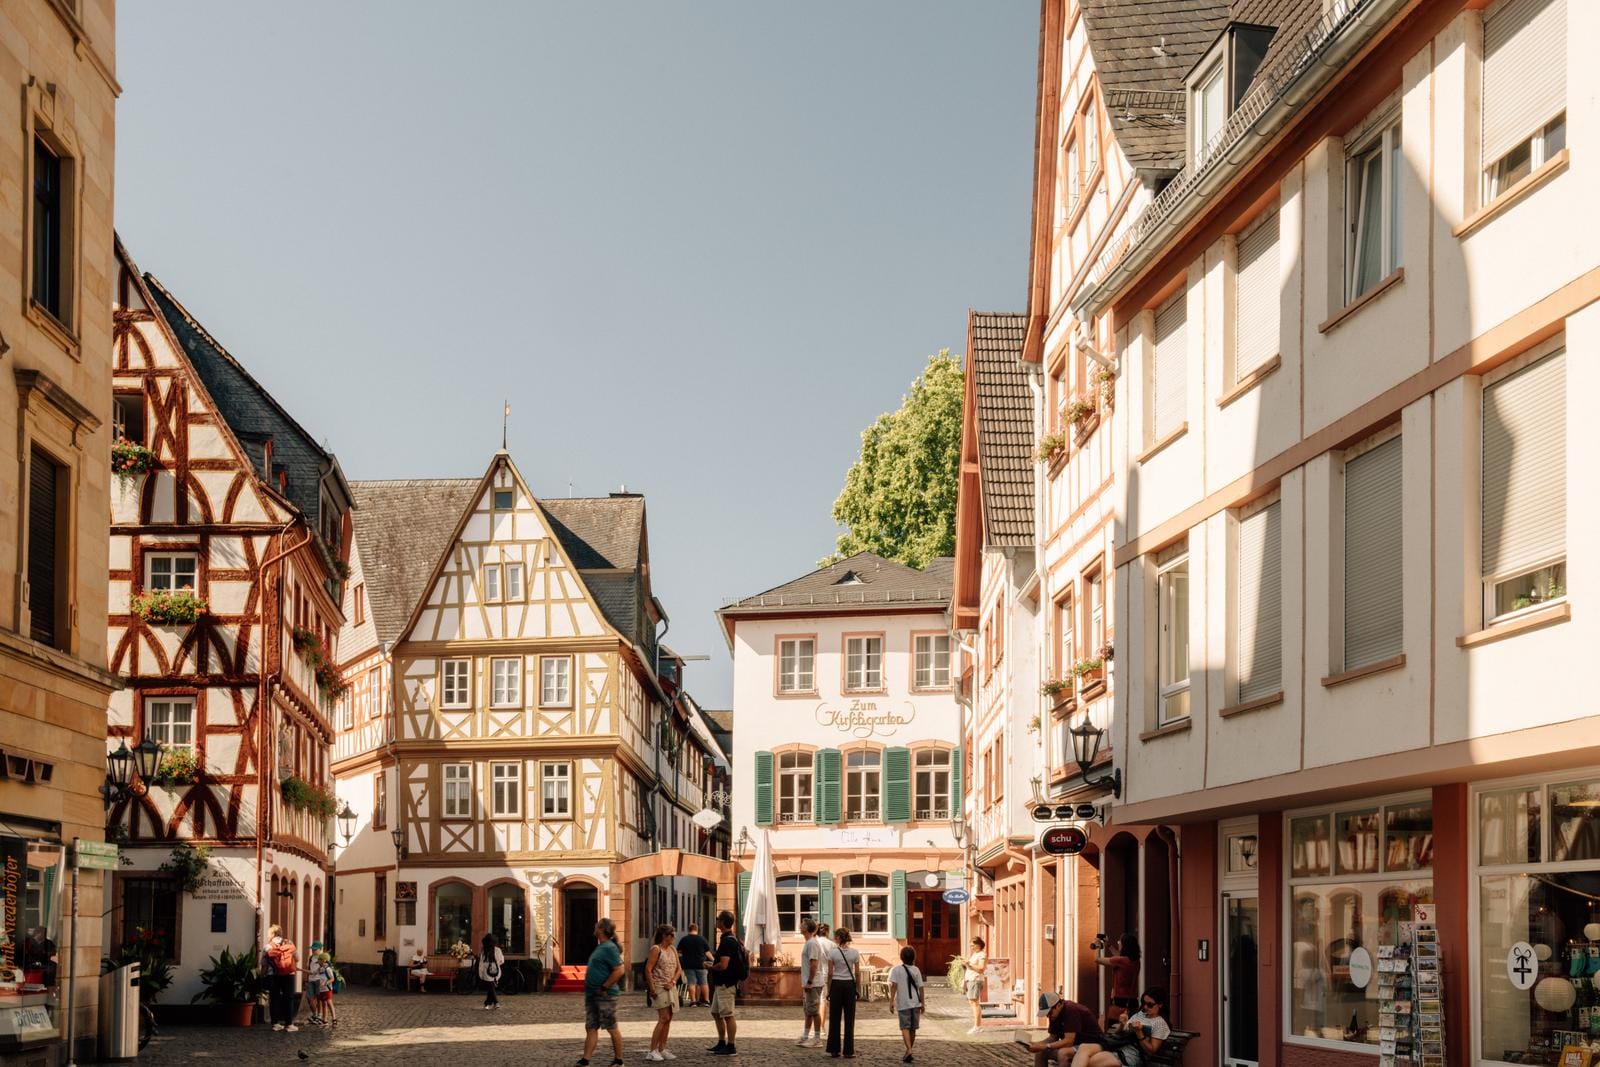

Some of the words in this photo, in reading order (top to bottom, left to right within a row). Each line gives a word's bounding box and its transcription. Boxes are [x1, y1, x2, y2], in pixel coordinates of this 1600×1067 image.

[850, 700, 877, 711] Zum
[1051, 834, 1072, 843] schu
[3, 856, 21, 938] Niederhöfer
[1, 941, 17, 980] Optik
